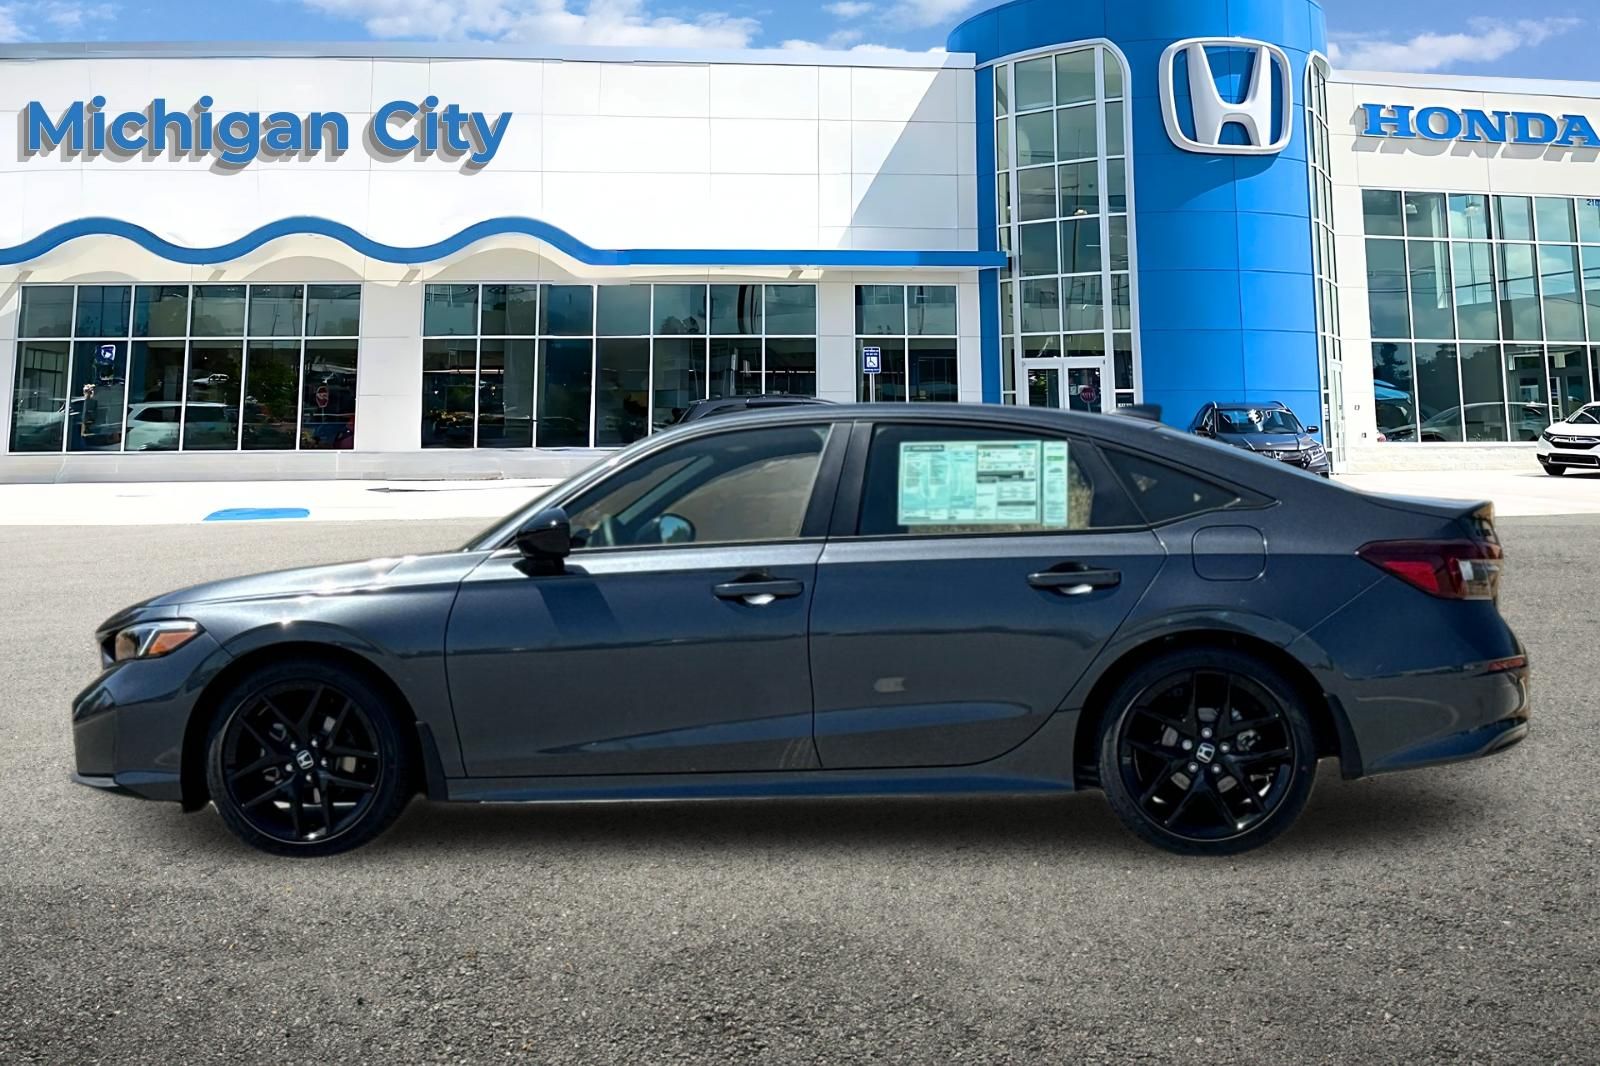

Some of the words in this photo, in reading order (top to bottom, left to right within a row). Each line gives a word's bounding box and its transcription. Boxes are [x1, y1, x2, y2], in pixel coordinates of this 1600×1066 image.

[27, 95, 350, 164] Michigan
[372, 95, 513, 164] City
[1361, 103, 1600, 148] HONDA
